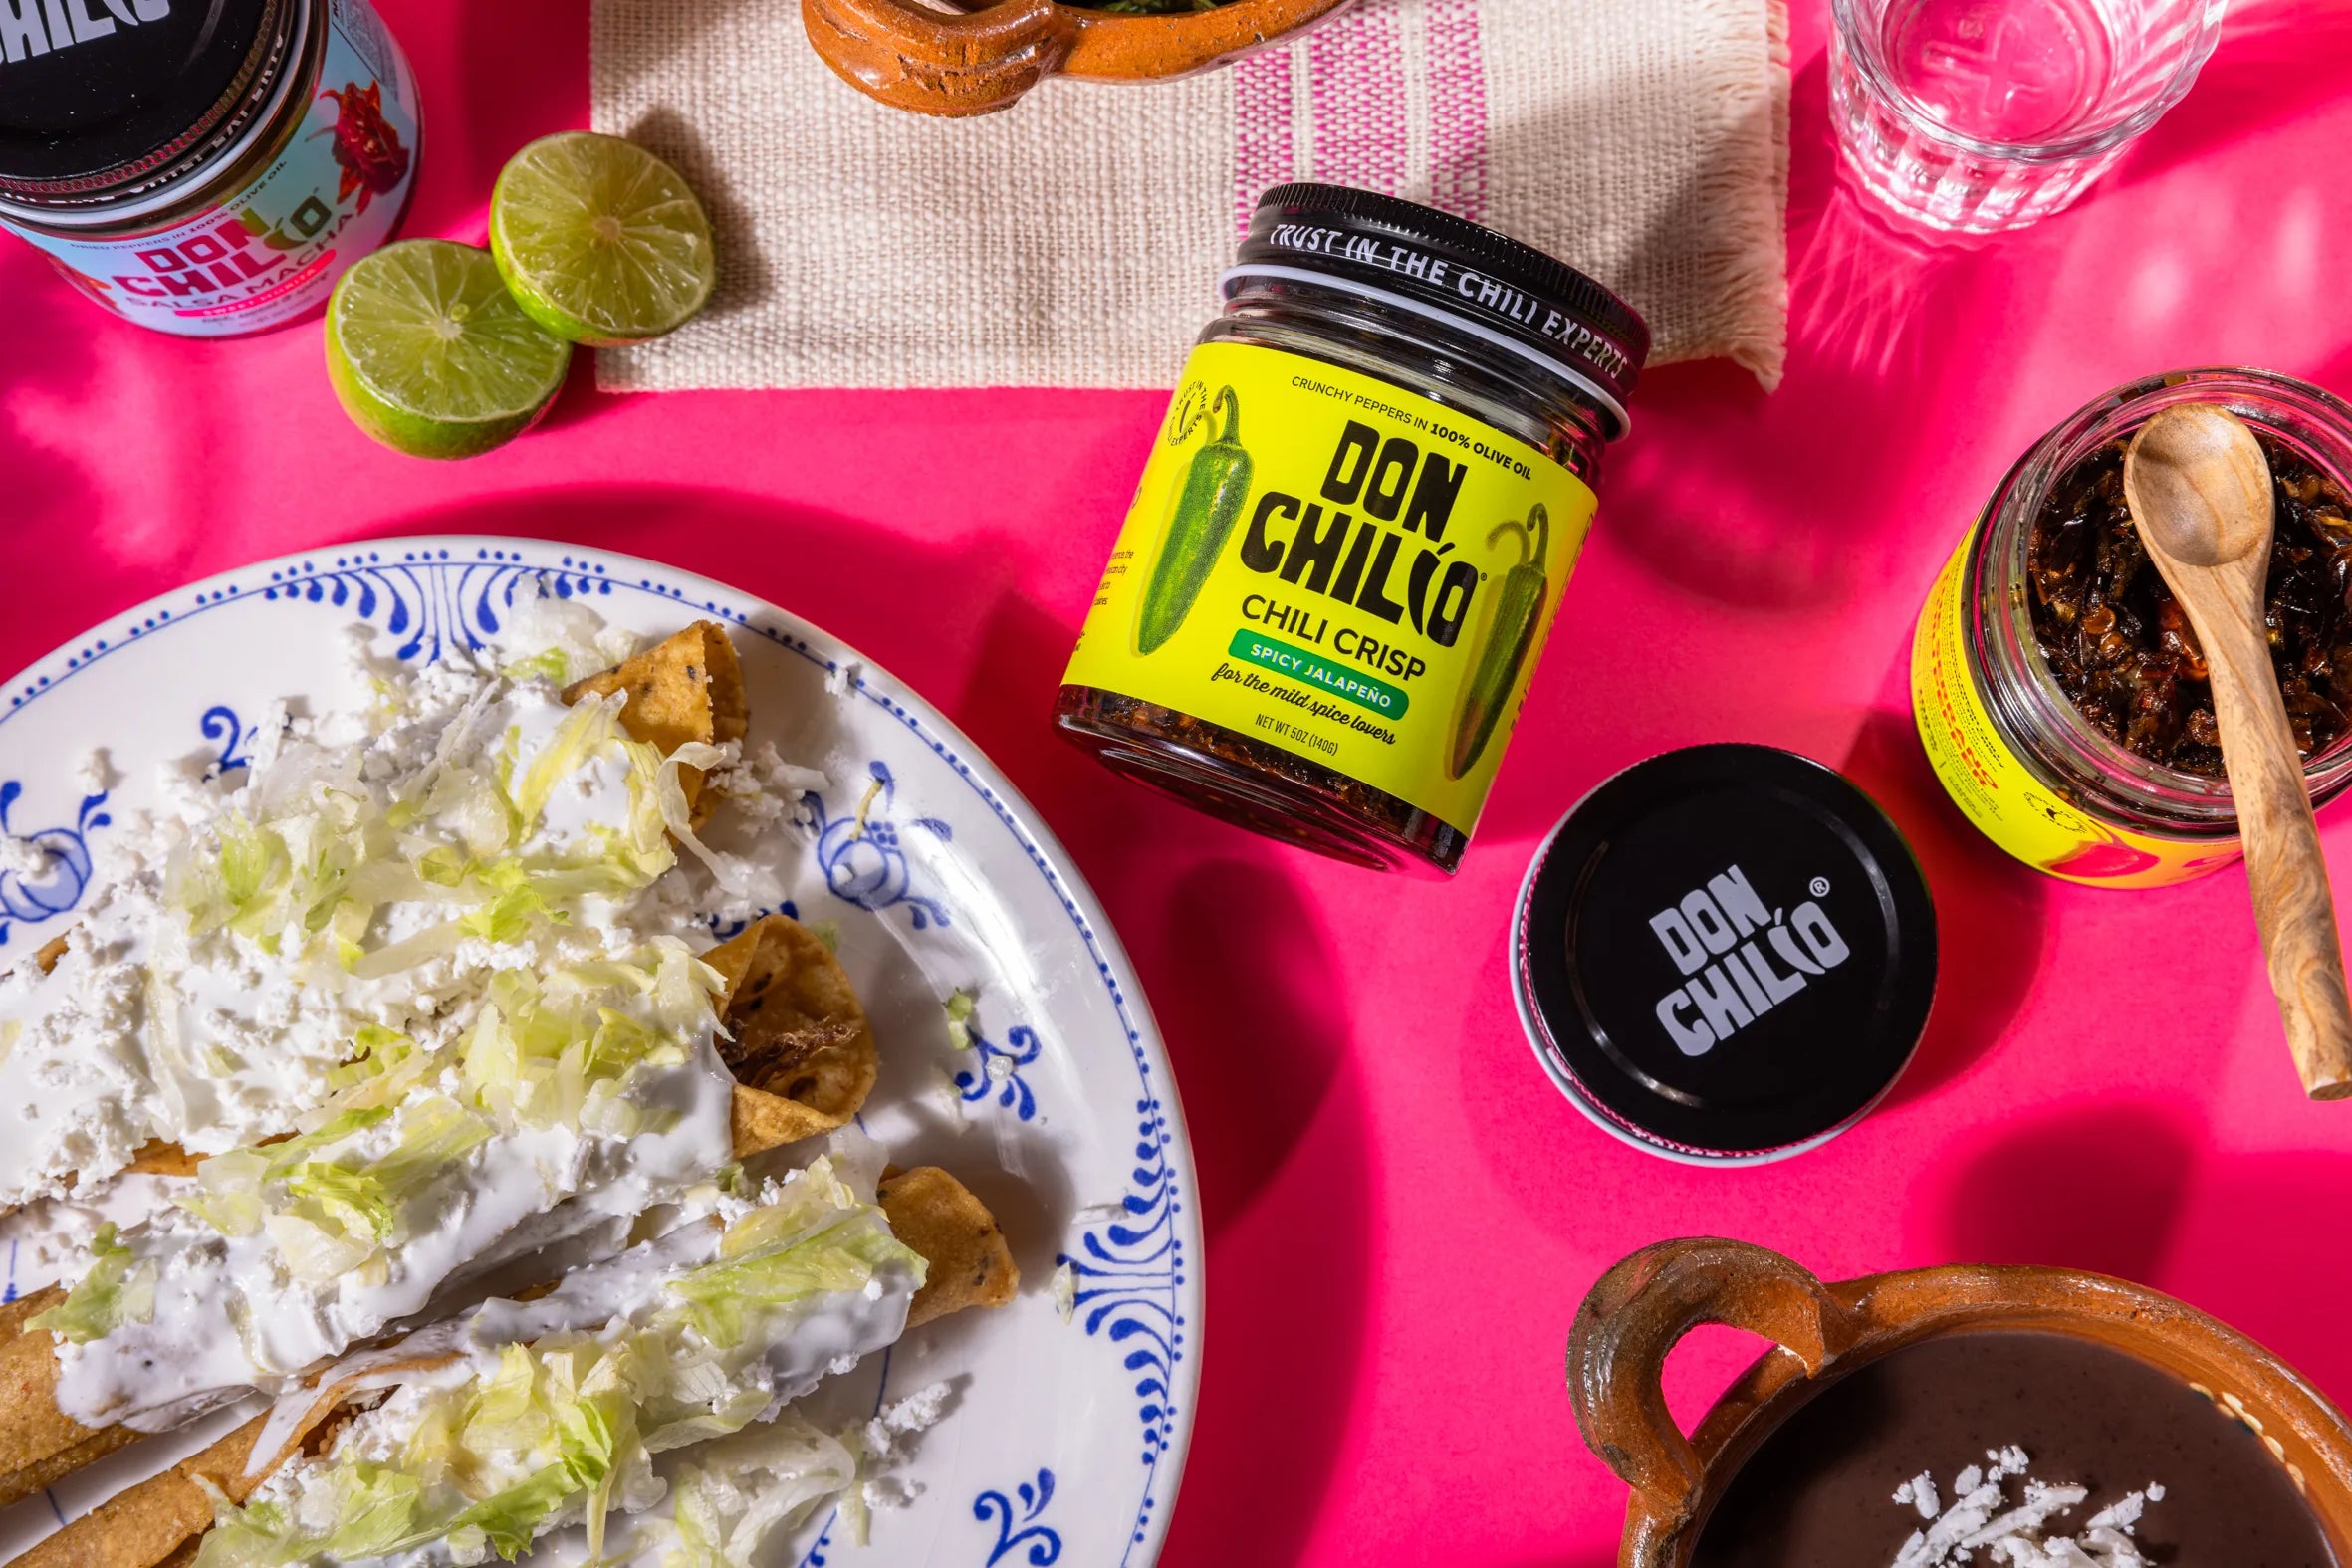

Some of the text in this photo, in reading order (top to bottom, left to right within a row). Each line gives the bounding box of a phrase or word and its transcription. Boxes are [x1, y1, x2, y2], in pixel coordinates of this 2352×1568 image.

[229, 180, 267, 211] OLIVE
[267, 161, 288, 180] OIL
[134, 207, 271, 274] DON
[245, 213, 353, 295] MACHA
[1270, 224, 1629, 379] TRUST IN THE CHILI EXPERTS
[1291, 375, 1532, 481] CRUNCHY PEPPERS IN 100% OLIVE OIL
[1320, 419, 1468, 543] DON
[1242, 593, 1427, 682] CHILI CRISP
[1251, 643, 1392, 709] SPICY JALAPEÑO
[1211, 662, 1396, 746] for the mild spice lovers
[1255, 713, 1275, 730] NET
[1274, 719, 1292, 736] WT
[1308, 729, 1339, 757] (140G)
[1649, 863, 1772, 977] DON
